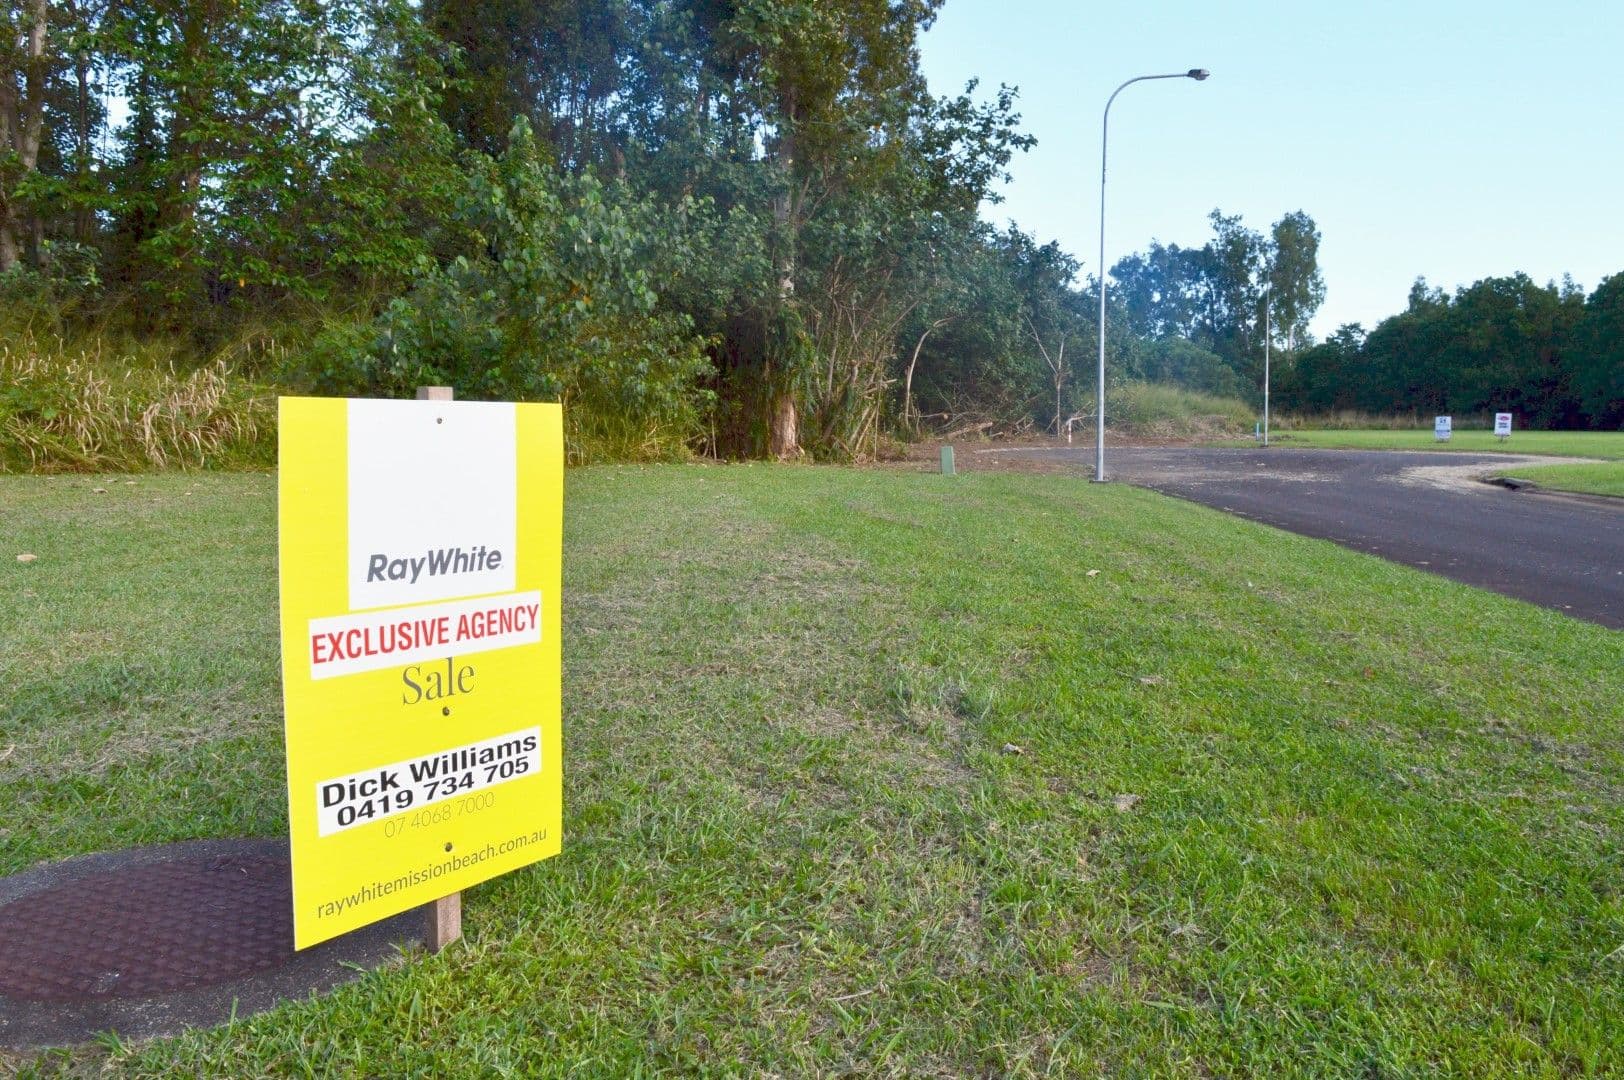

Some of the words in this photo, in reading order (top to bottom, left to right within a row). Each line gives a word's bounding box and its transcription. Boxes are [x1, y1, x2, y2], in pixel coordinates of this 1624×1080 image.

[311, 616, 449, 664] EXCLUSIVE
[456, 604, 540, 641] AGENCY
[402, 656, 475, 705] Sale
[322, 769, 399, 808] Dick
[409, 735, 537, 783] Williams
[337, 789, 414, 828] 0419
[424, 771, 475, 805] 734
[485, 756, 530, 784] 705
[384, 818, 405, 839] 07
[410, 806, 452, 830] 4068
[457, 791, 495, 817] 7000
[317, 829, 547, 919] raywhitemissionbeach.com.au
